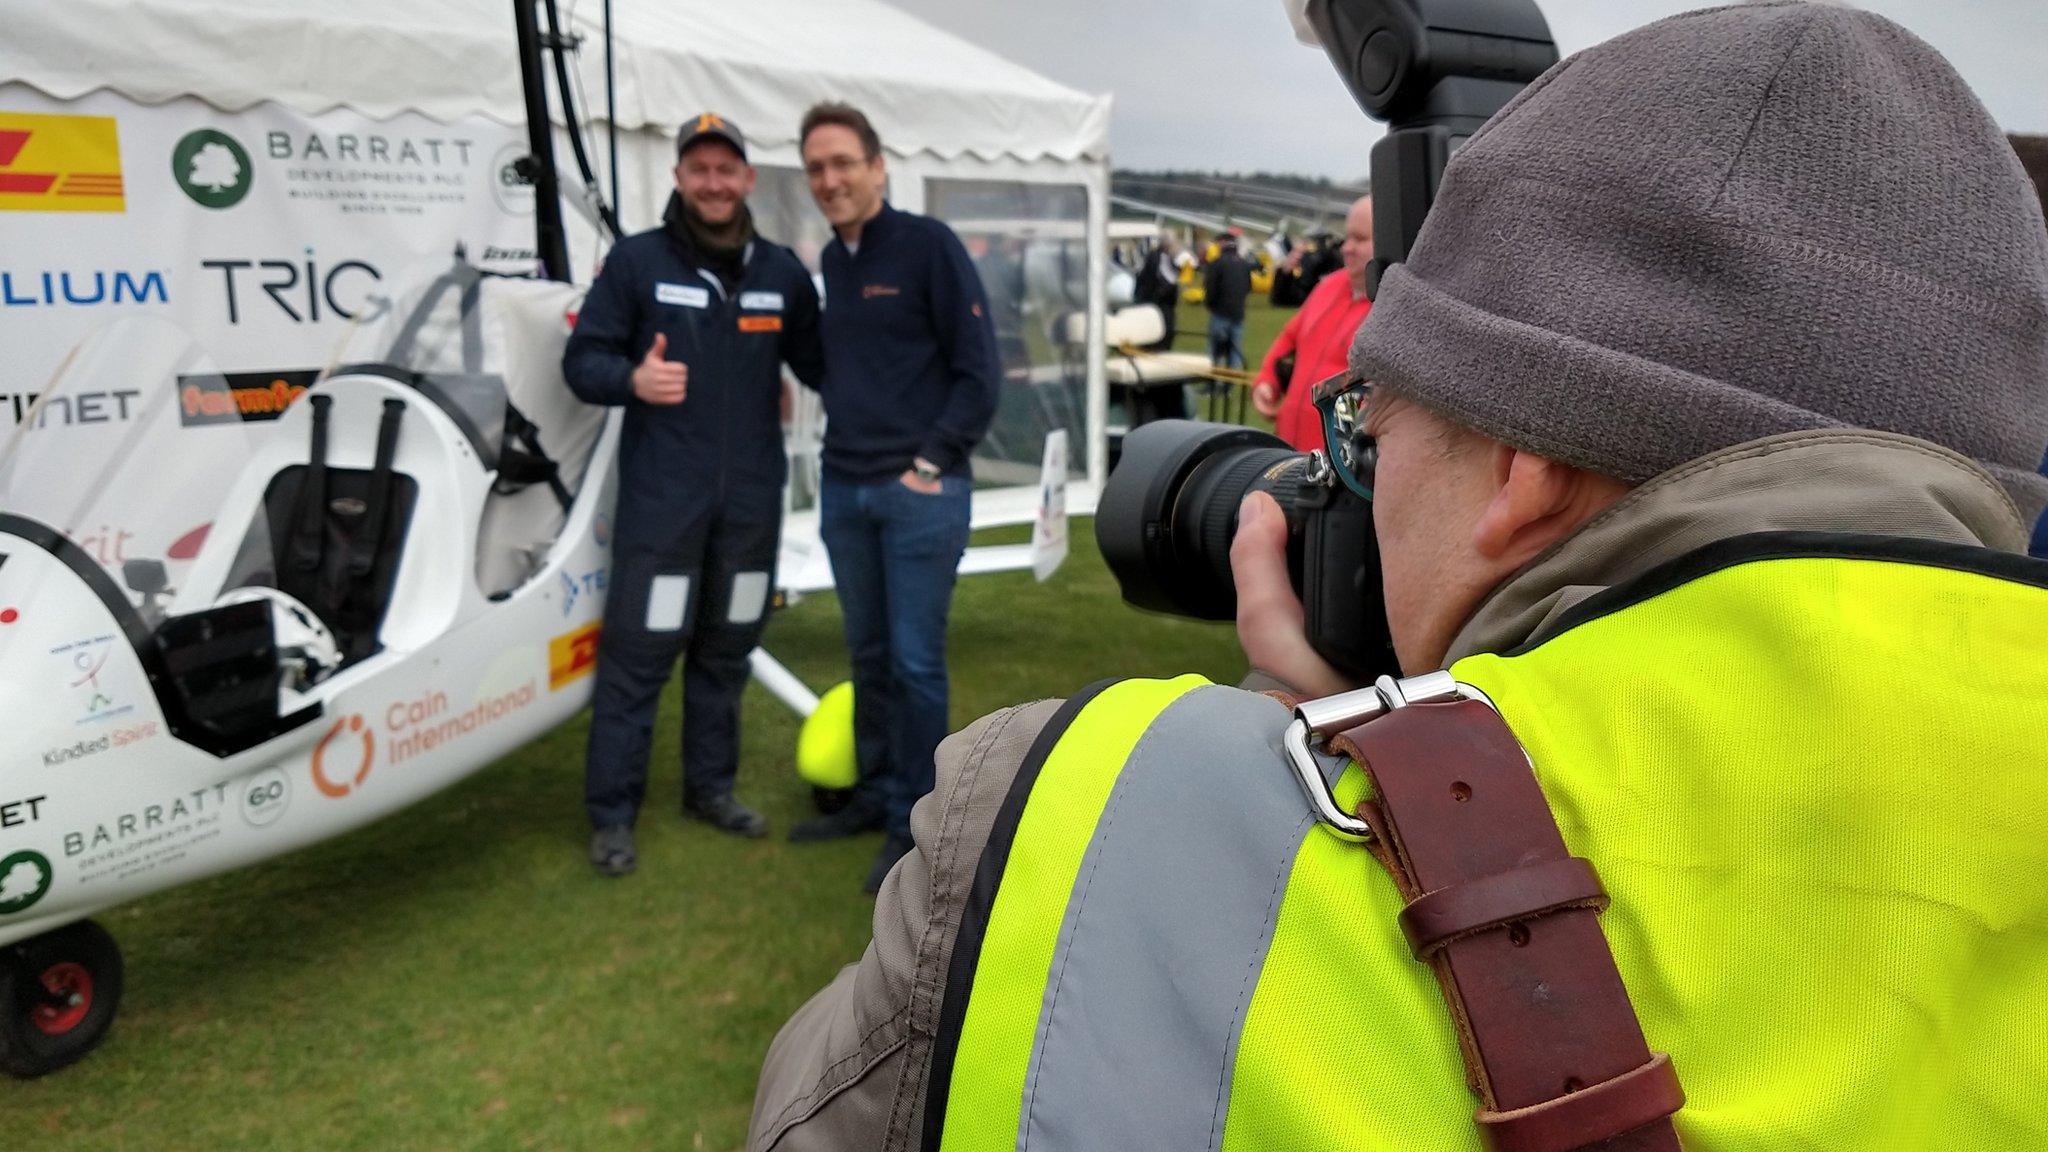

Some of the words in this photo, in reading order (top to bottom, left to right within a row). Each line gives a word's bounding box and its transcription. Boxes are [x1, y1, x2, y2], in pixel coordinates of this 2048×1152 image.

[267, 131, 474, 166] BARRATT
[2, 271, 170, 306] LIUM
[0, 387, 141, 432] INET
[386, 689, 448, 732] Cain
[388, 678, 536, 765] International
[42, 733, 109, 768] Kindled
[0, 795, 46, 829] ET
[63, 780, 230, 857] BARRATT
